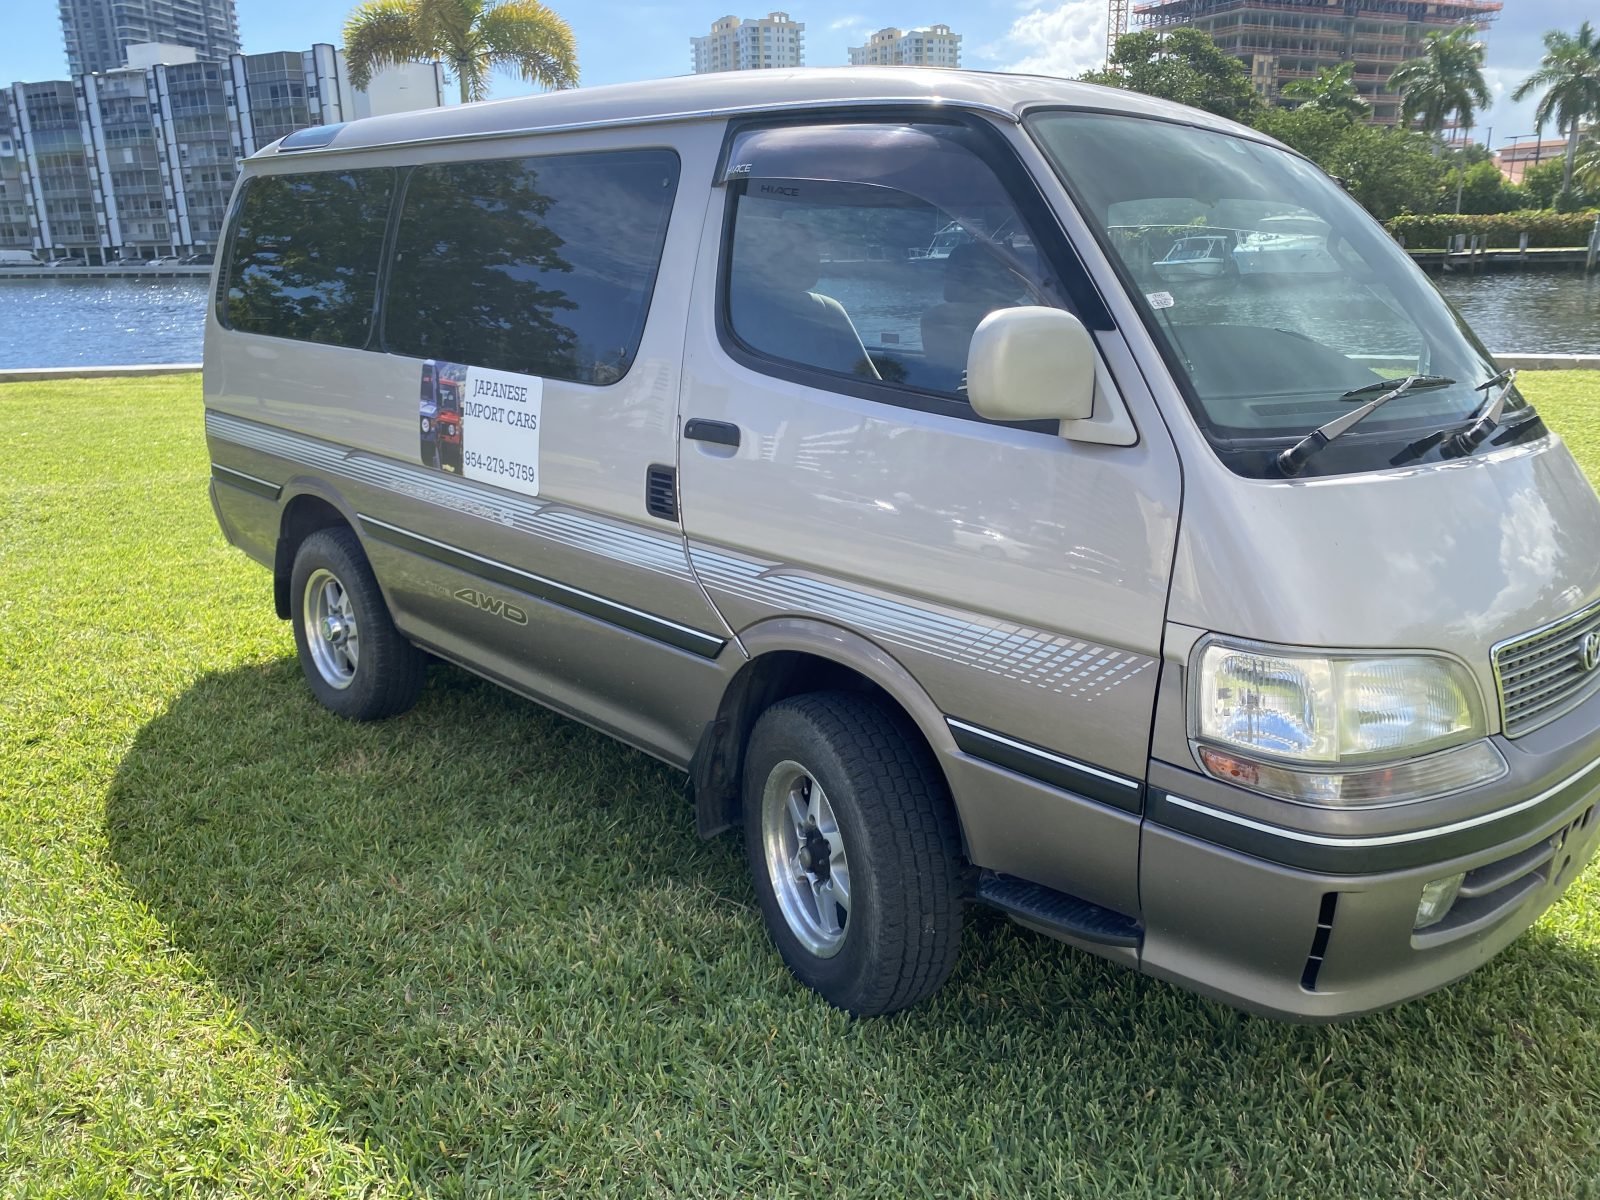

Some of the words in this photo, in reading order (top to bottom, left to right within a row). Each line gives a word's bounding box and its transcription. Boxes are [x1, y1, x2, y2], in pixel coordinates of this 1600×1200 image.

[727, 163, 752, 174] HIACE
[760, 184, 800, 197] HIACE
[473, 379, 528, 403] JAPANESE
[465, 401, 505, 423] IMPORT
[507, 410, 537, 430] CARS
[464, 451, 535, 483] 954-279-5759
[454, 588, 529, 625] 4WD
